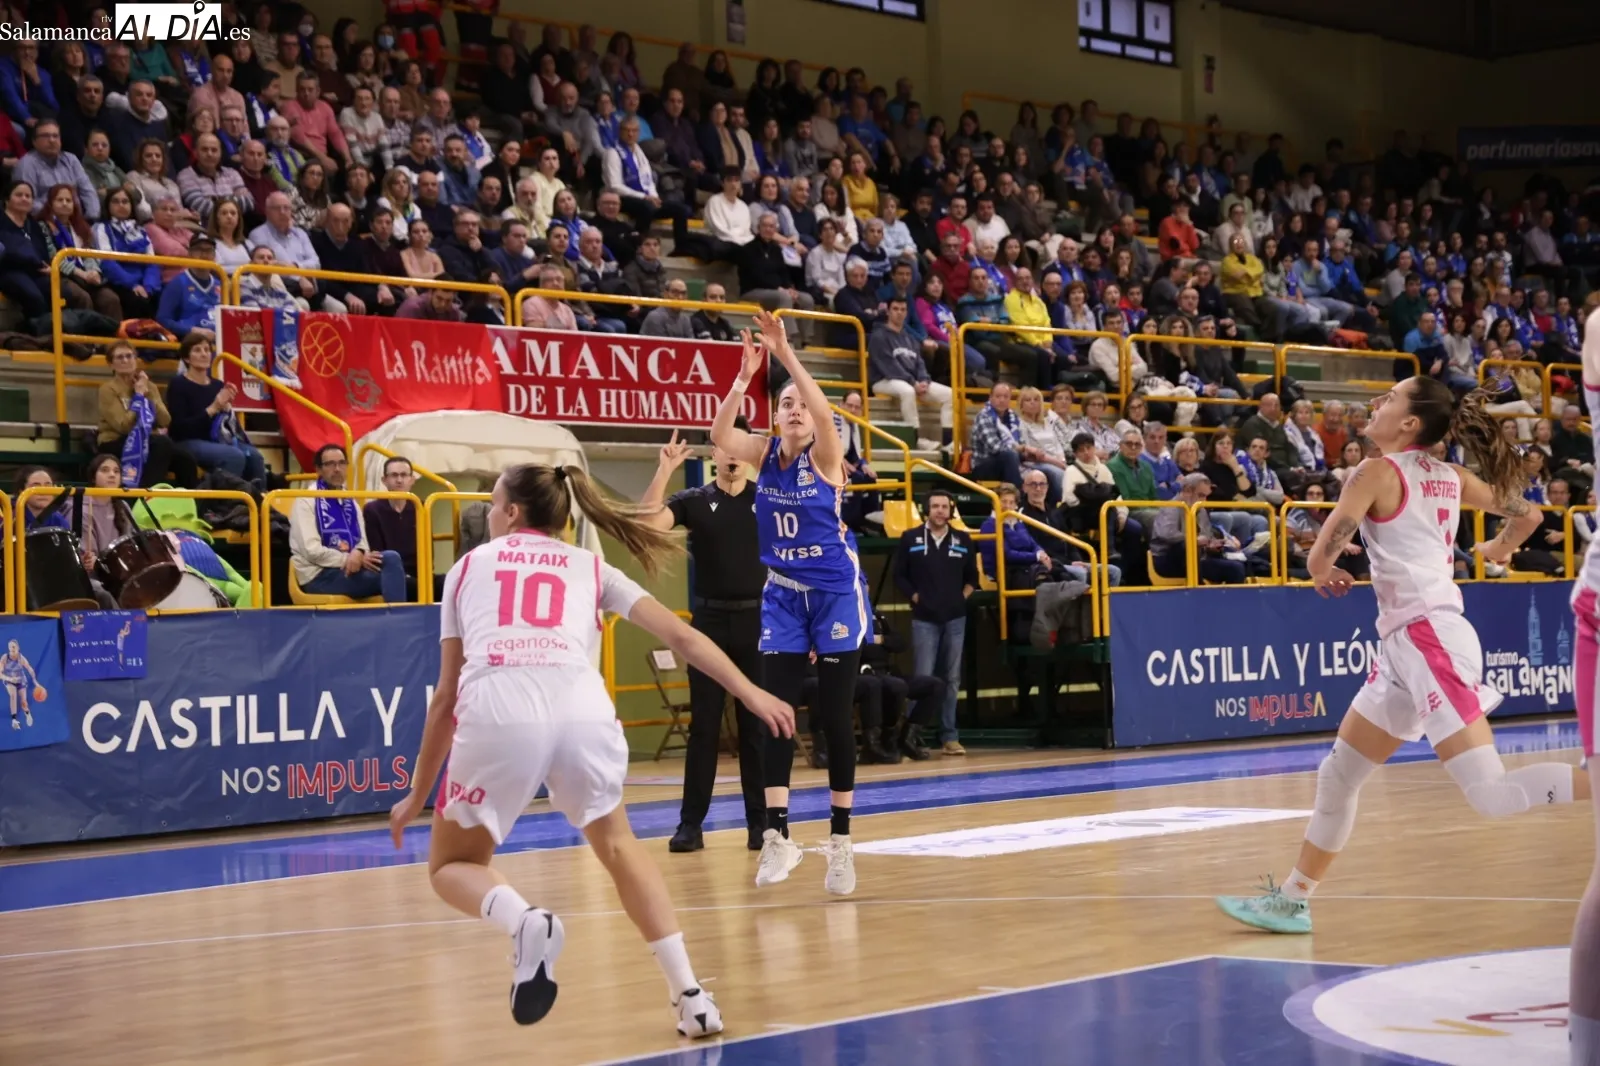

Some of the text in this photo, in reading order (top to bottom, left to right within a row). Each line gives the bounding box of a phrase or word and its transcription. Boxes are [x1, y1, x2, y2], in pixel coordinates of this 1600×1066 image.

[379, 337, 493, 386] La Ranita
[491, 336, 716, 386] AMANCA
[507, 383, 757, 423] DE LA HUMANIDD
[796, 487, 818, 499] LEÓN
[1419, 480, 1457, 500] MESTRES
[772, 511, 799, 539] 10
[497, 550, 569, 568] MATAIX
[494, 570, 567, 628] 10
[487, 636, 569, 652] reganosa
[1146, 627, 1382, 687] CASTILLA Y LEÓN
[1486, 648, 1519, 667] turismo
[82, 690, 346, 755] CASTILLA
[370, 686, 404, 747] Y
[1215, 690, 1328, 727] NOS IMPULSA
[221, 754, 421, 804] NOS IMPULS
